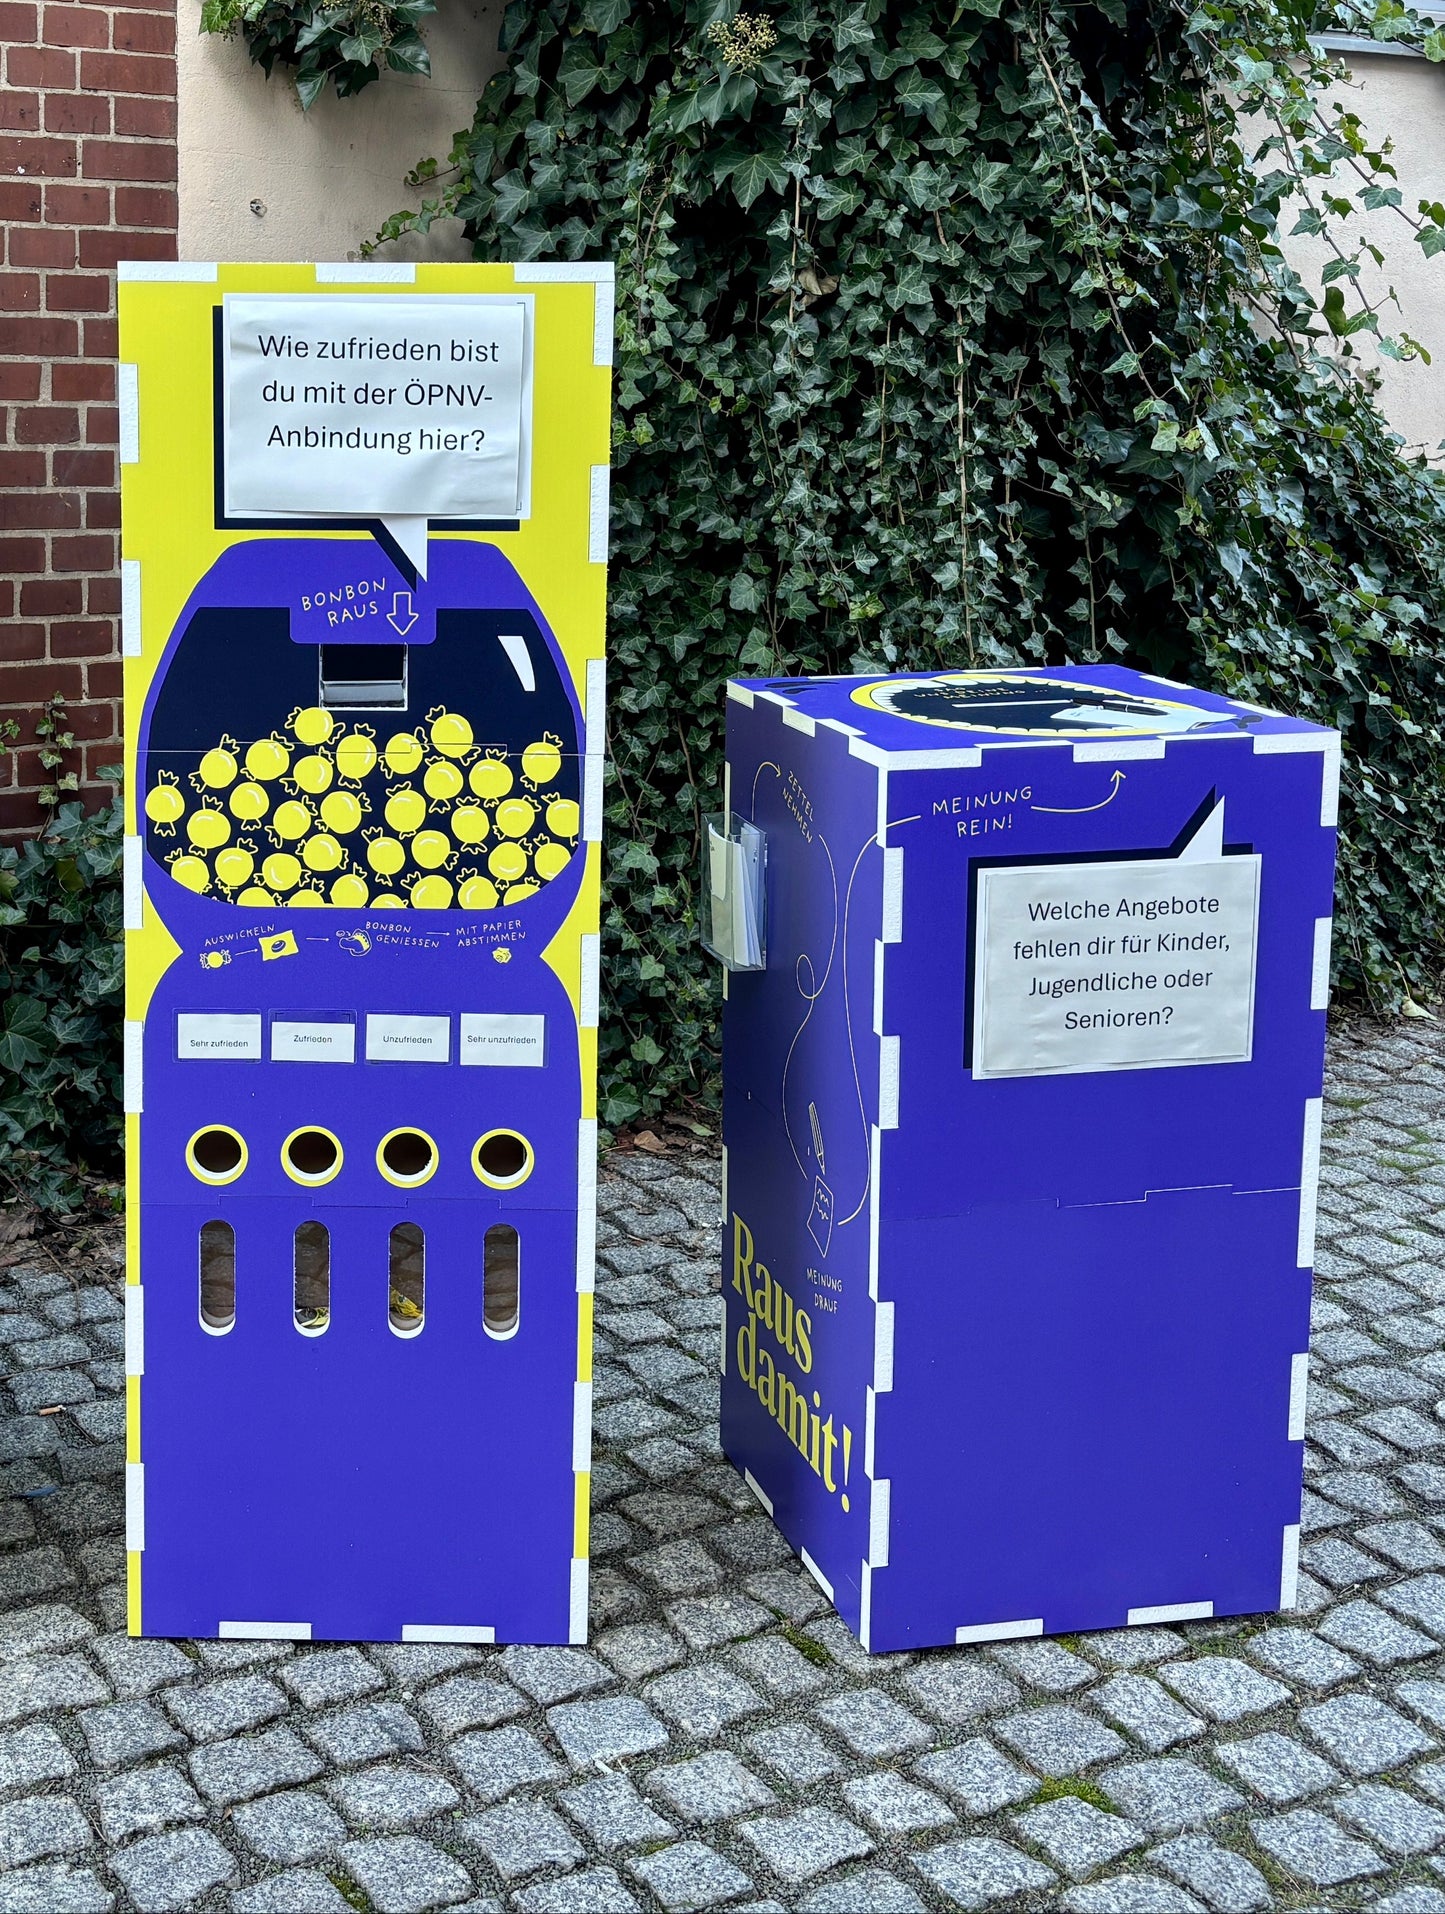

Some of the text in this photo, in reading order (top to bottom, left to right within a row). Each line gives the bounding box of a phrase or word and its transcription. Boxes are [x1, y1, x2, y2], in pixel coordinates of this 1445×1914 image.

[258, 335, 499, 362] Wie zufrieden bist
[262, 378, 493, 407] du mit der ÖPNV-
[267, 425, 485, 455] Anbindung hier?
[301, 577, 385, 611] BONBON
[327, 601, 378, 627] RAUS
[788, 770, 813, 822] ZETTEL
[932, 786, 1032, 815] MEINUNG
[783, 787, 813, 843] NEHMEN
[957, 813, 1012, 837] REIN!
[1028, 896, 1220, 921] Welche Angebote
[204, 923, 275, 947] AUSWICKELN
[365, 921, 412, 933] BONBON
[456, 919, 522, 936] MIT PAPIER
[457, 931, 526, 947] ABSTIMMEN
[376, 934, 440, 948] GENIESSEN
[1013, 932, 1230, 959] fehlen dir für Kinder,
[1028, 969, 1213, 999] Jugendliche oder
[1064, 1006, 1174, 1029] Senioren?
[190, 1039, 249, 1048] Sehr zufrieden
[293, 1034, 333, 1044] Zufrieden
[383, 1035, 433, 1044] Unzufrieden
[467, 1035, 537, 1044] Sehr unzufrieden
[806, 1267, 842, 1292] MEINUNG
[731, 1211, 813, 1374] Raus
[814, 1292, 838, 1314] DRAUF
[737, 1311, 852, 1513] damit!
